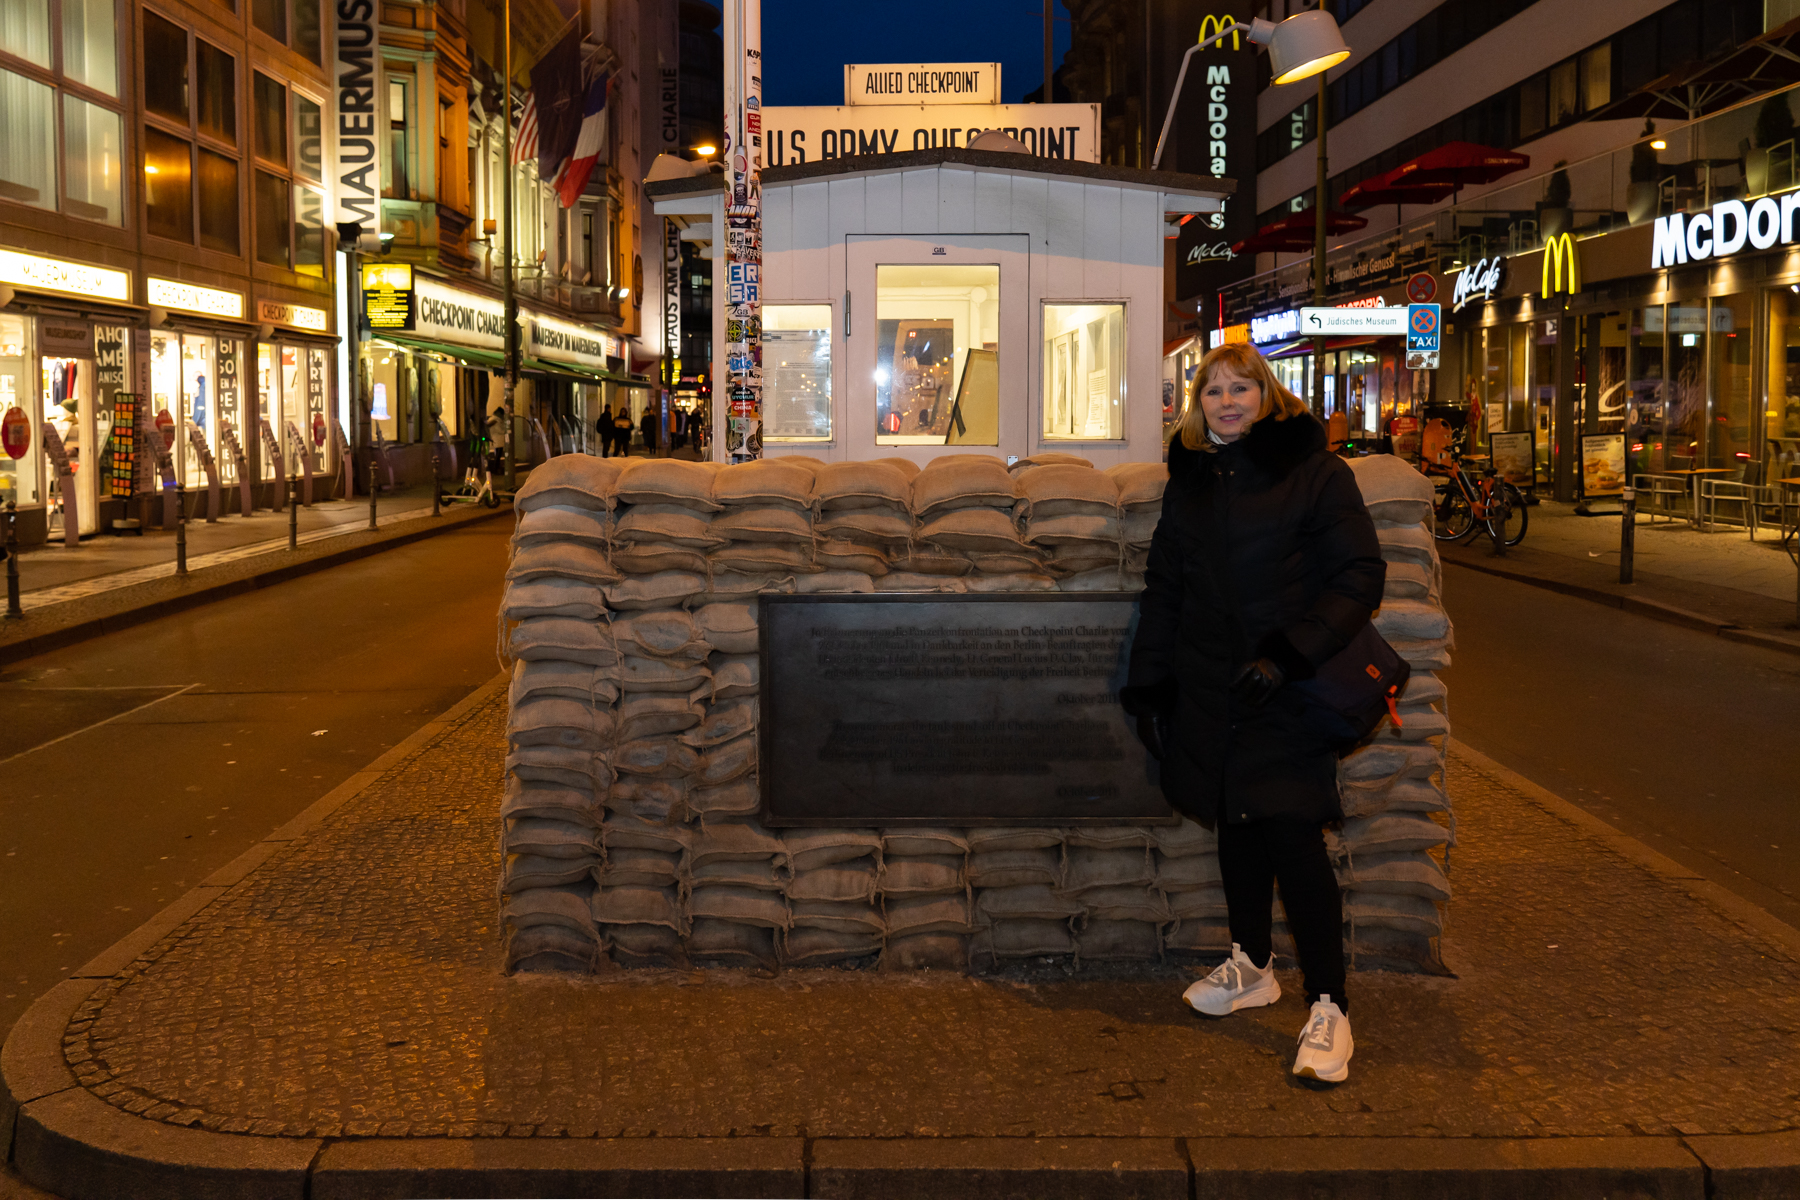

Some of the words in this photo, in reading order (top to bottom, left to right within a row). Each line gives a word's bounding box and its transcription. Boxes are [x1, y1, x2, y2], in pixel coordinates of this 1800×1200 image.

[866, 71, 903, 95] ALLIED
[908, 71, 980, 94] CHECKPOINT
[662, 68, 678, 142] CHARLIE
[822, 129, 899, 161] ARMY
[1369, 251, 1396, 274] Genuss!
[23, 262, 102, 292] MAUERMUSEUM
[1453, 256, 1501, 308] McCafé
[263, 303, 297, 323] CHECKPOINT
[421, 296, 475, 331] CHECKPOINT
[477, 310, 506, 337] CHARLIE
[1326, 316, 1363, 326] Jüdisches
[1366, 317, 1397, 326] Museum
[1411, 337, 1436, 347] TAXI
[1021, 625, 1074, 638] Checkpoint
[1075, 625, 1109, 636] Charlie
[1057, 693, 1095, 705] Oktober
